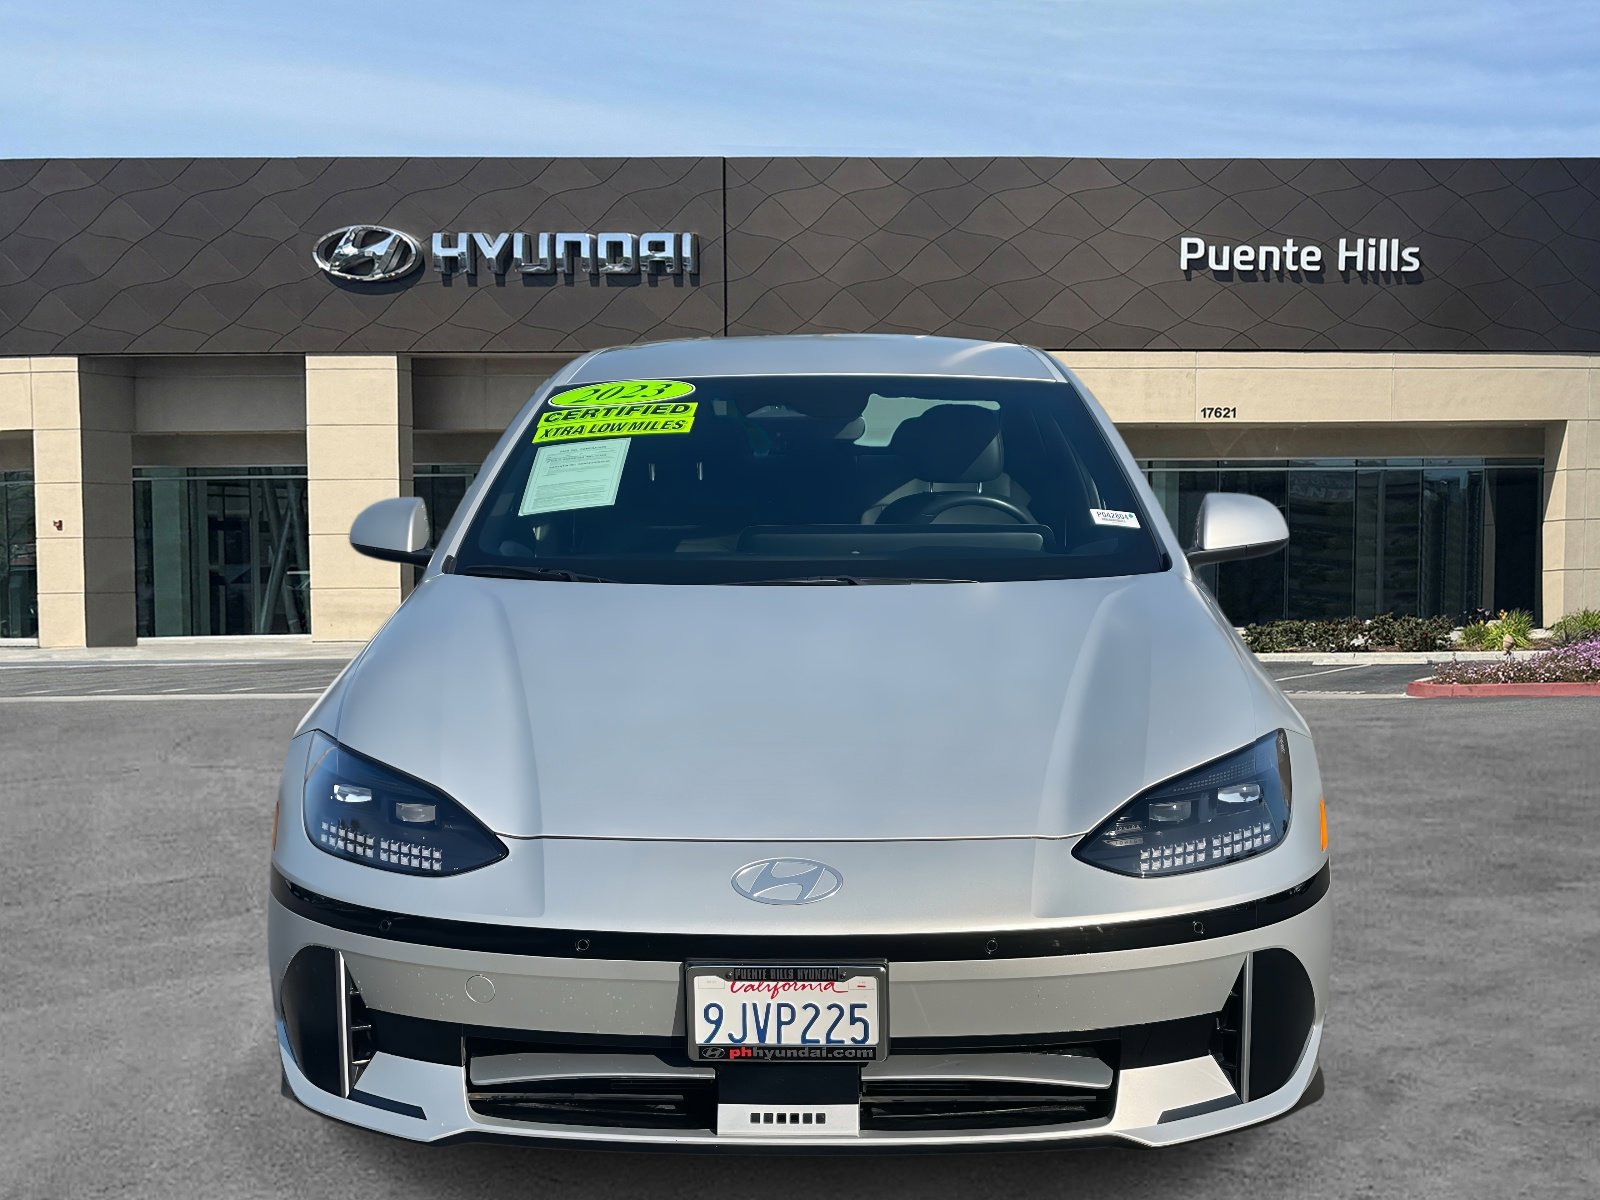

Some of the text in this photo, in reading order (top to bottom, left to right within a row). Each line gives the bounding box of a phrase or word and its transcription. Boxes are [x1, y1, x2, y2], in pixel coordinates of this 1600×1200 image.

[432, 231, 700, 275] HYUNDAI
[1180, 237, 1421, 273] Puente Hills
[571, 382, 673, 404] 2023
[543, 402, 692, 424] CERTIFIED
[1200, 406, 1237, 419] 17621
[540, 418, 686, 439] XTRA LOW MILES
[734, 968, 838, 980] PUENTE HILLS HYUNDAI
[730, 980, 849, 1000] California
[703, 1002, 870, 1045] 9JVP225
[729, 1046, 874, 1061] phhyundai.com
